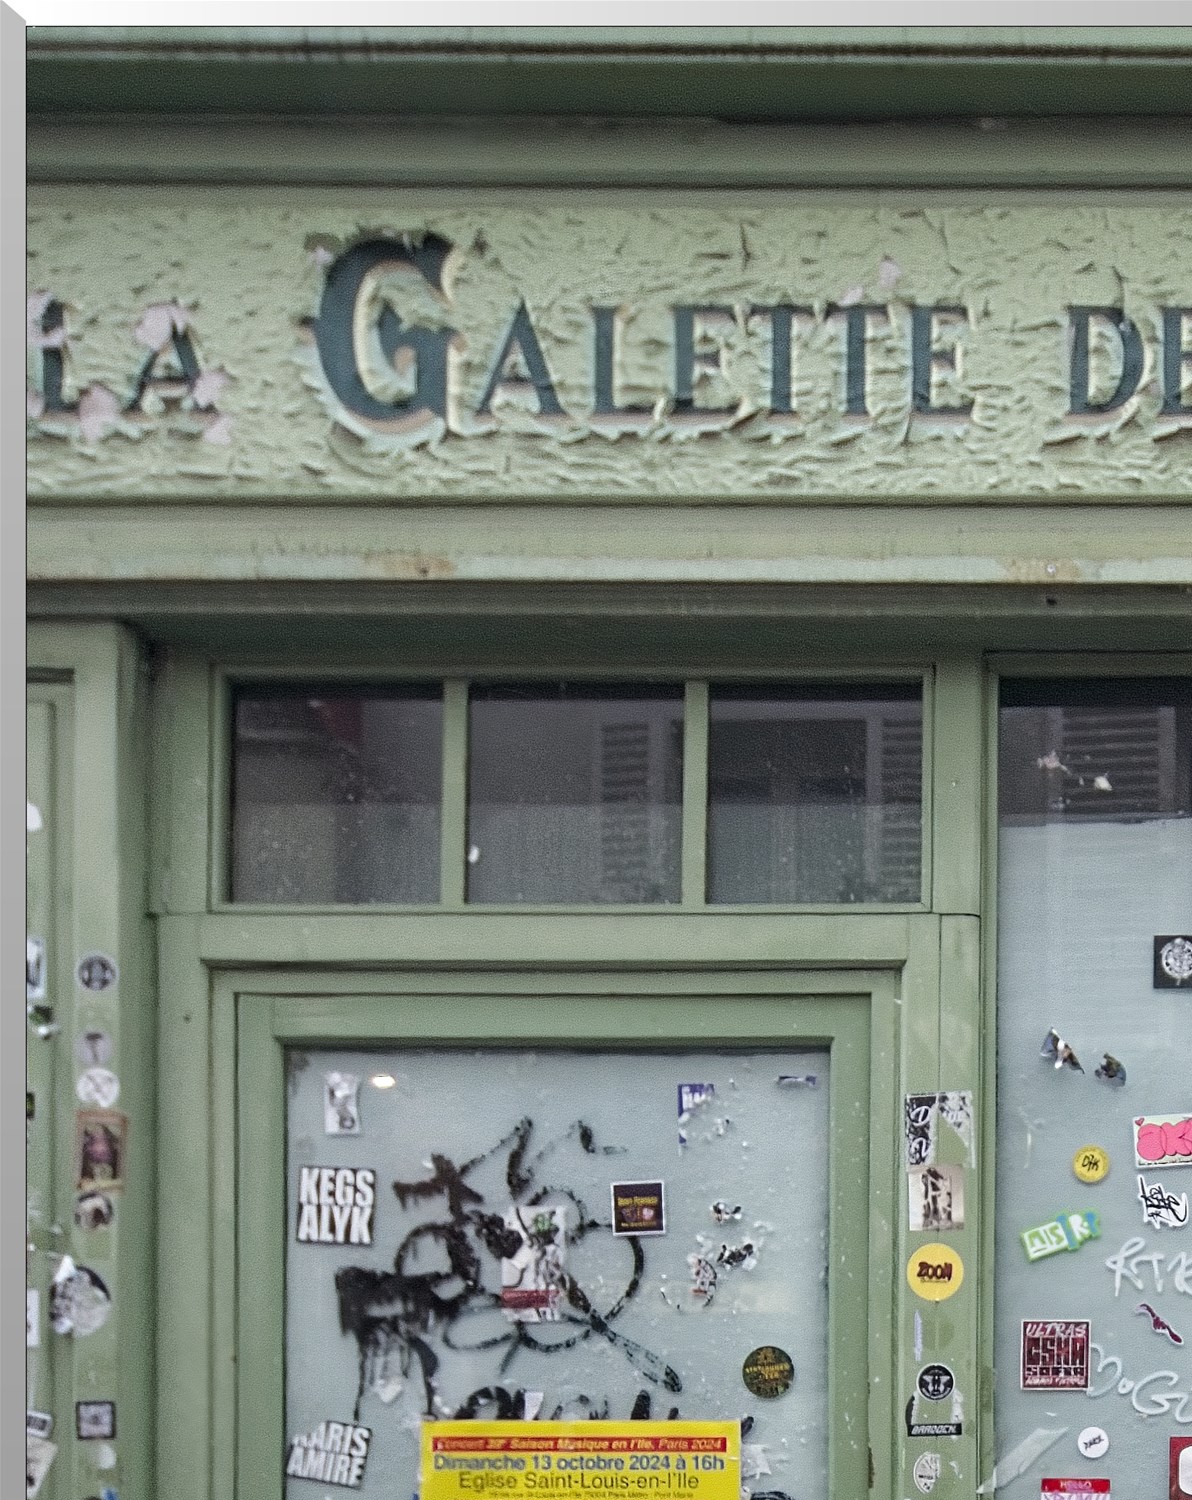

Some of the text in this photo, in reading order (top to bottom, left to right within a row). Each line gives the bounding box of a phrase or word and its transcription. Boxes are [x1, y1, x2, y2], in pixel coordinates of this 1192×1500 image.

[312, 230, 974, 420] GALETTE
[300, 1169, 374, 1205] KEGS
[298, 1205, 371, 1243] ALYK
[1025, 1322, 1087, 1338] ULTRAS
[434, 1453, 724, 1471] Dimanche 13 octobre 2024 à 16h
[459, 1472, 517, 1492] Eglise
